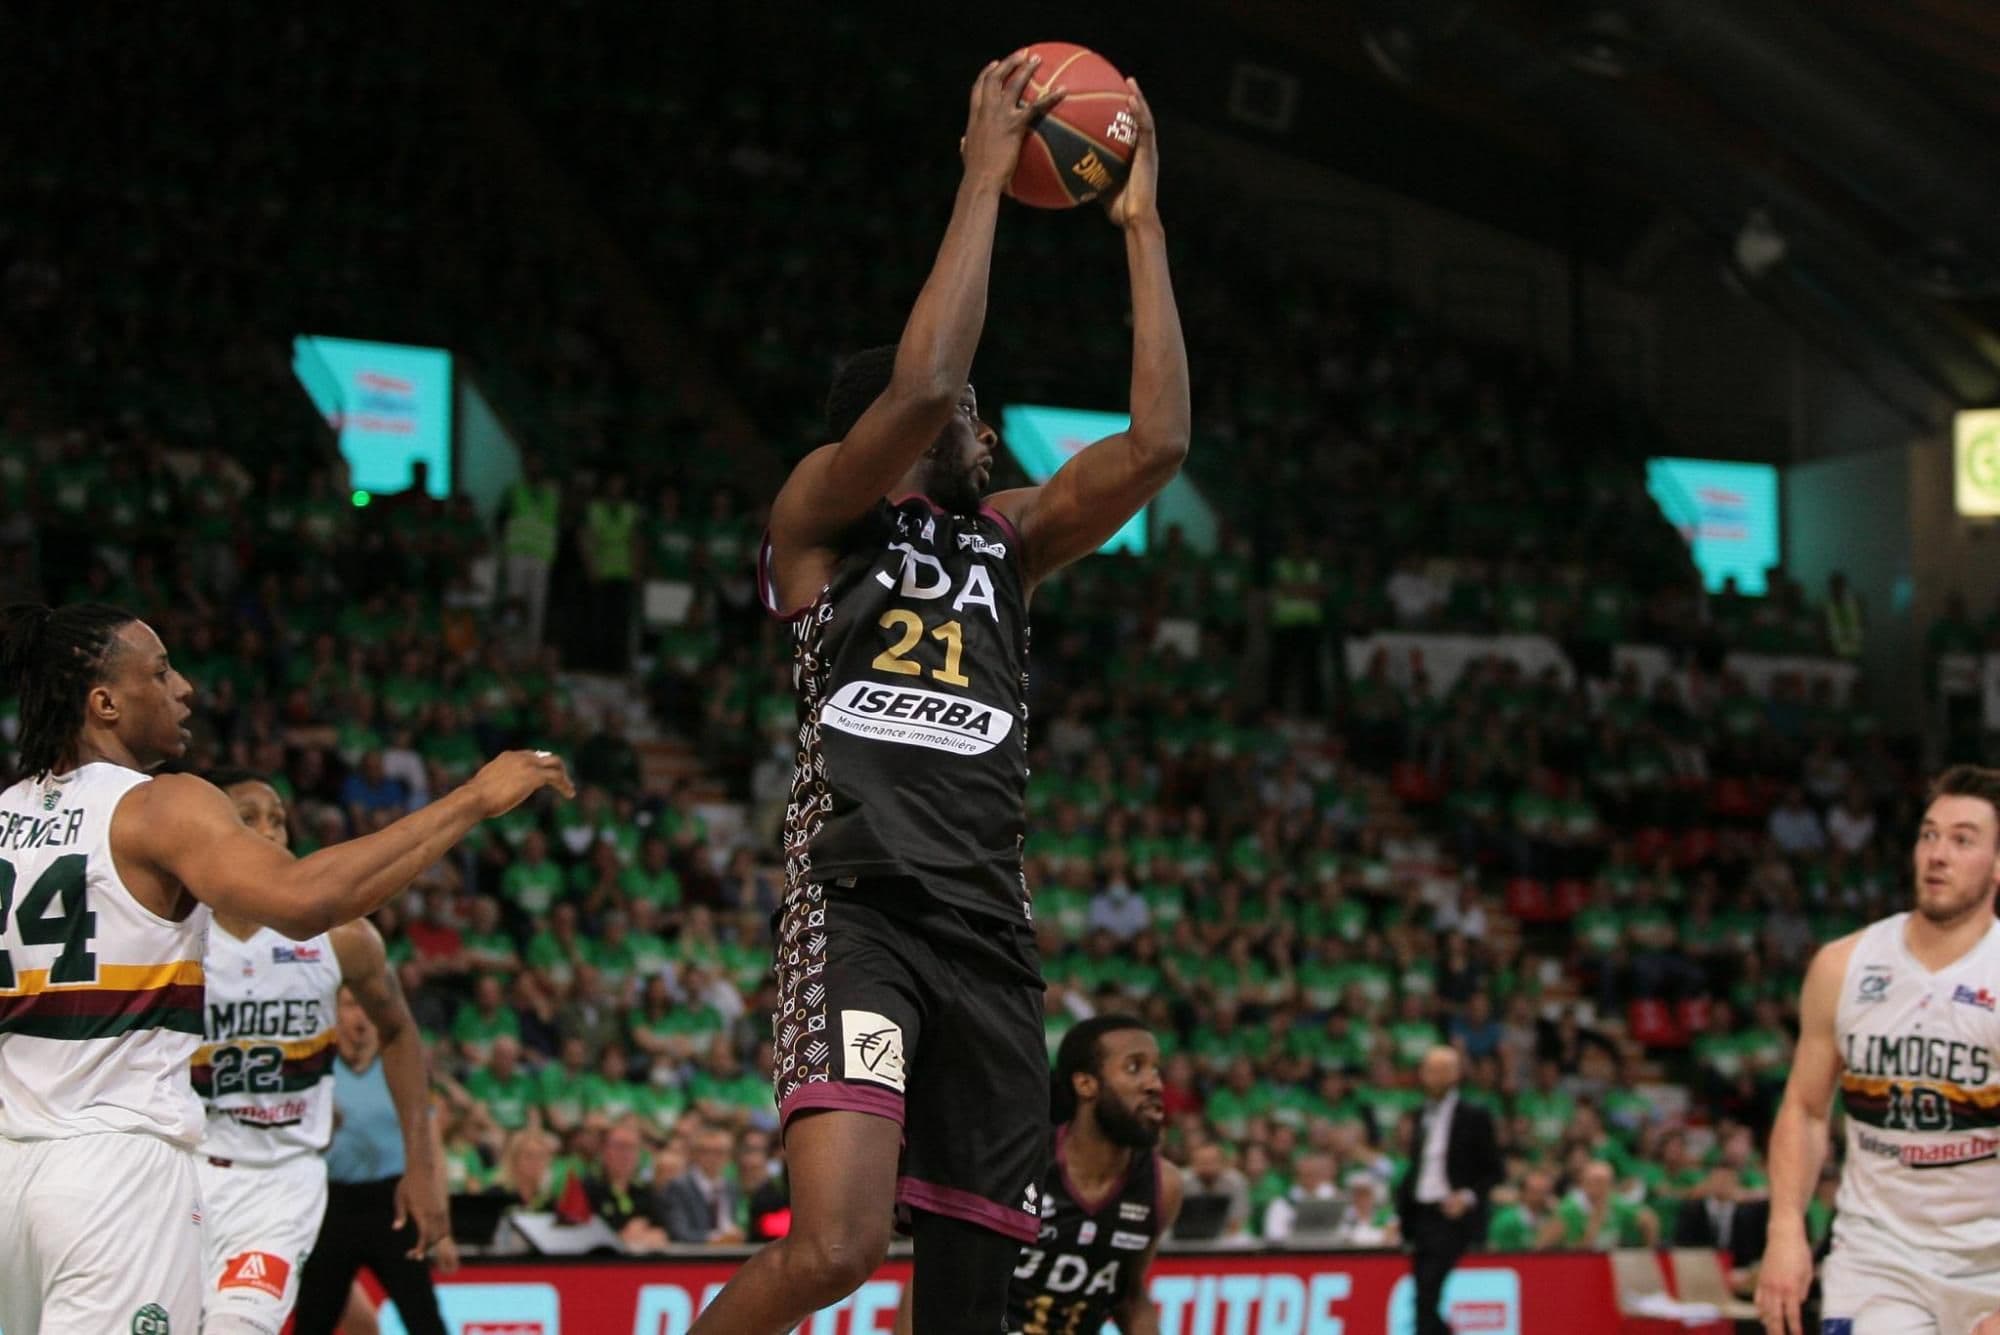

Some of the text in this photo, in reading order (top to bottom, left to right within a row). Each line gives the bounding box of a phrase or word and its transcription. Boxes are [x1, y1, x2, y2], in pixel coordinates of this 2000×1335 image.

[872, 609, 968, 687] 21
[837, 715, 977, 752] Maintenance immobilière
[848, 686, 991, 736] ISERBA
[203, 1000, 322, 1041] MOGES
[213, 1045, 284, 1096] 22
[1846, 1034, 1989, 1085] LIMOGES
[1887, 1083, 1950, 1131] 10
[1013, 1247, 1120, 1295] JDA
